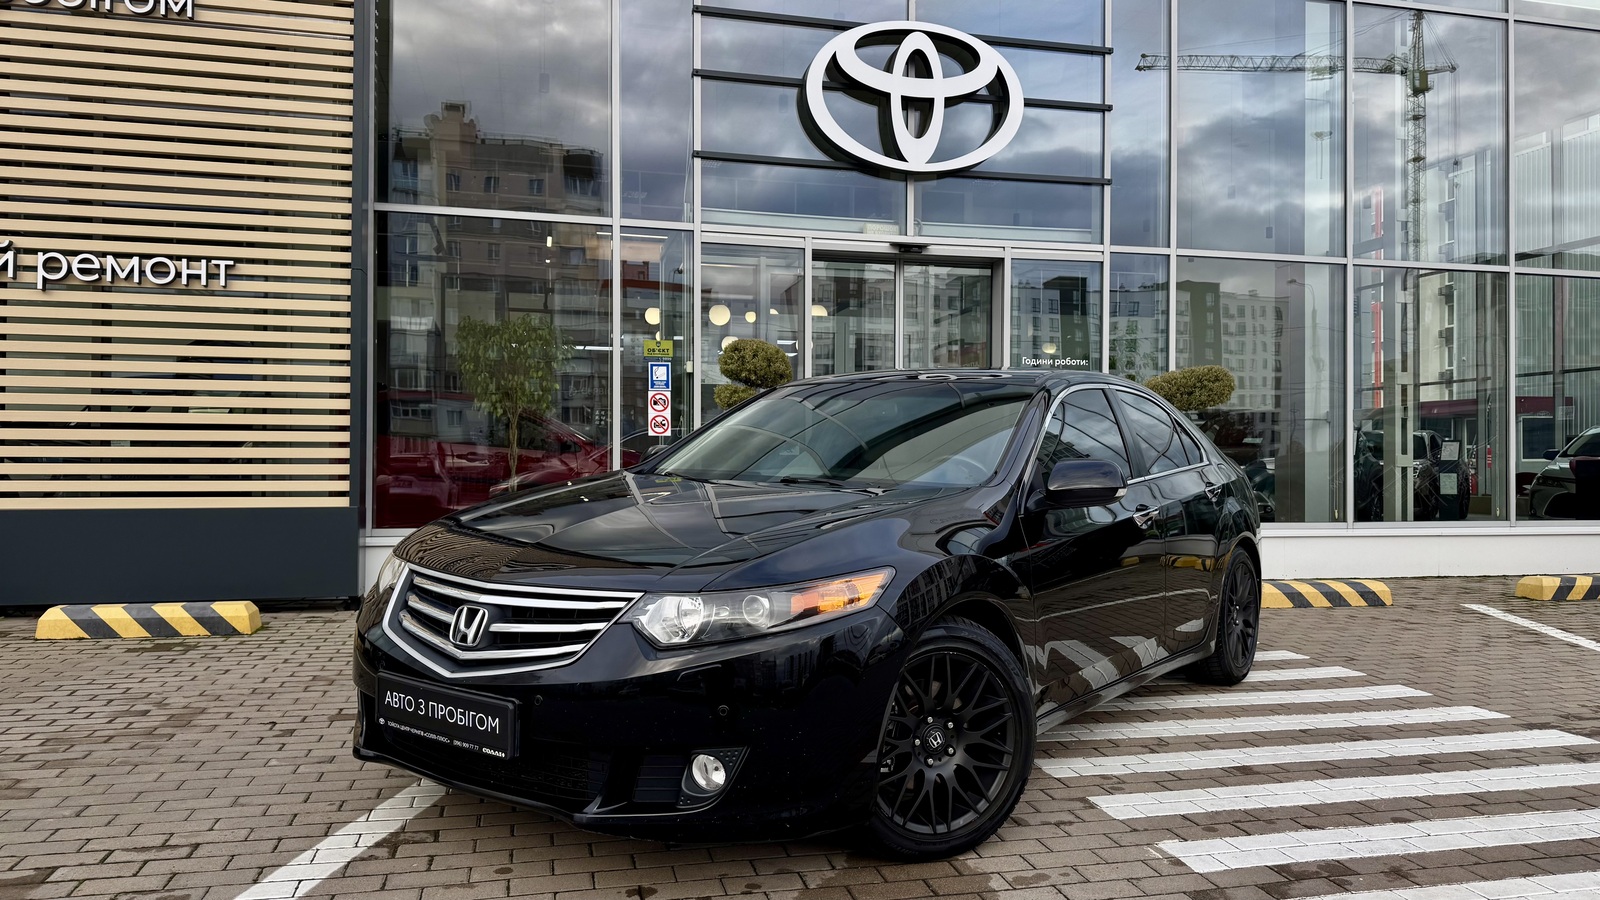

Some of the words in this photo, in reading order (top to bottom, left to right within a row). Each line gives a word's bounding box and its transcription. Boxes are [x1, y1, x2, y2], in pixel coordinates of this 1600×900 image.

[36, 251, 235, 291] ремонт
[1022, 357, 1053, 366] Години
[1054, 357, 1089, 367] роботи:
[385, 691, 415, 712] АВТО
[429, 702, 499, 734] ПРОБІГОМ
